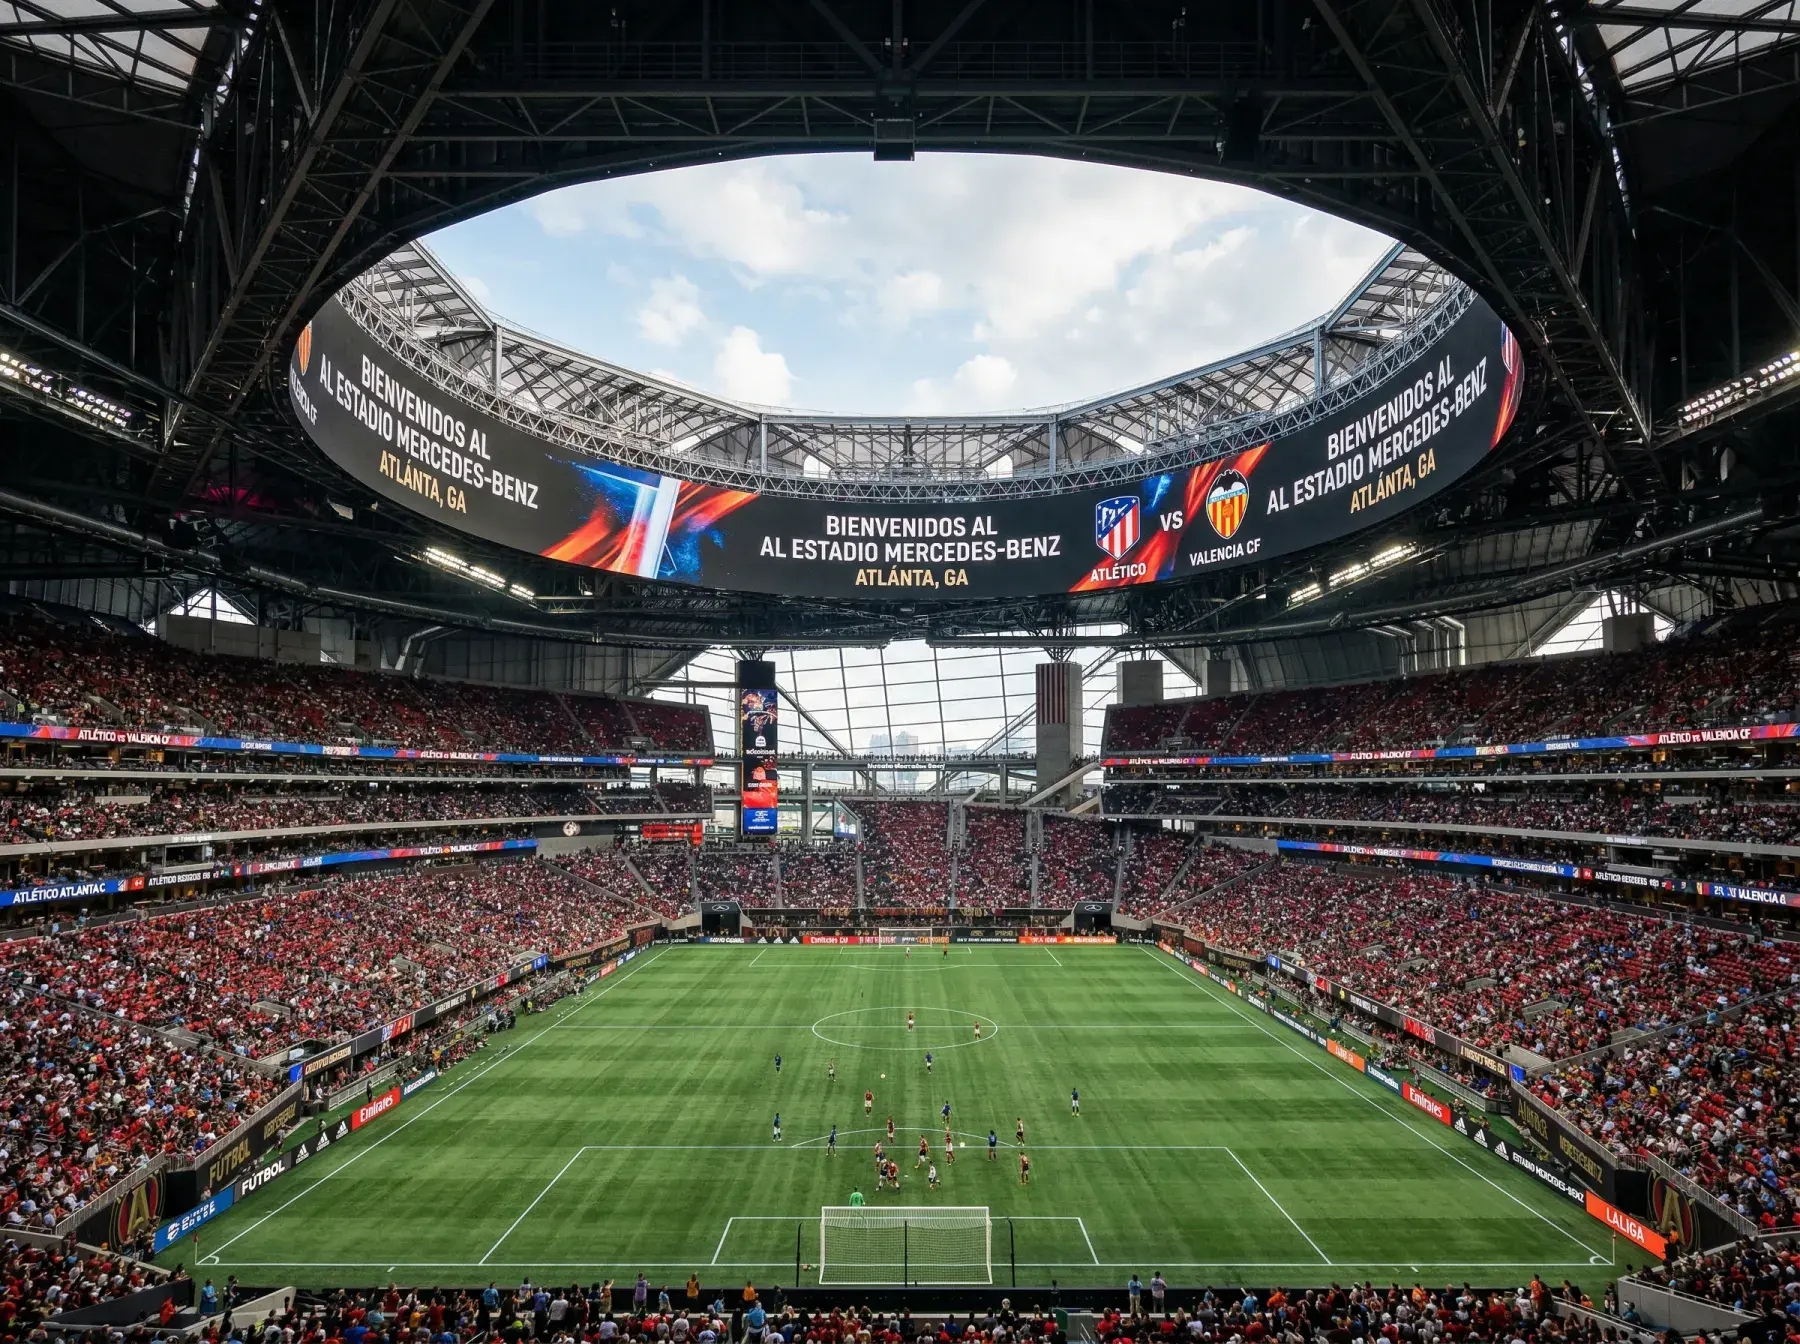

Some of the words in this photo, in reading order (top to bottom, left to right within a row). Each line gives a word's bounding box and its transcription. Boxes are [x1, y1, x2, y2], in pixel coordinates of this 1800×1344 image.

[361, 353, 466, 448] BIENVENIDOS
[470, 427, 491, 461] AL
[1328, 369, 1433, 461] BIENVENIDOS
[1437, 354, 1455, 394] AL
[319, 353, 334, 396] AL
[337, 374, 393, 442] ESTADIO
[397, 424, 539, 510] MERCEDES-BENZ
[1266, 485, 1289, 515] AL
[1293, 454, 1364, 507] ESTADIO
[1368, 356, 1487, 473] MERCEDES-BENZ
[379, 449, 444, 509] ATLÁNTA,
[446, 484, 467, 514] GA
[1350, 465, 1416, 514] ATLÁNTA,
[1418, 448, 1436, 479] GA
[826, 515, 966, 538] BIENVENIDOS
[972, 515, 998, 536] AL
[1160, 510, 1183, 532] VS
[760, 537, 787, 558] AL
[792, 539, 879, 562] ESTADIO
[884, 535, 1061, 562] MERCEDES-BENZ
[1189, 544, 1244, 566] VALENCIA
[1246, 538, 1262, 554] CF
[855, 563, 940, 589] ATLÁNTA,
[944, 568, 969, 587] GA
[1090, 562, 1147, 582] ATLÉTICO
[13, 887, 59, 904] ATLÉTICO
[60, 884, 99, 899] ATLANTA
[241, 1160, 286, 1196] FÚTBOL
[1606, 1207, 1645, 1244] LALIGA
